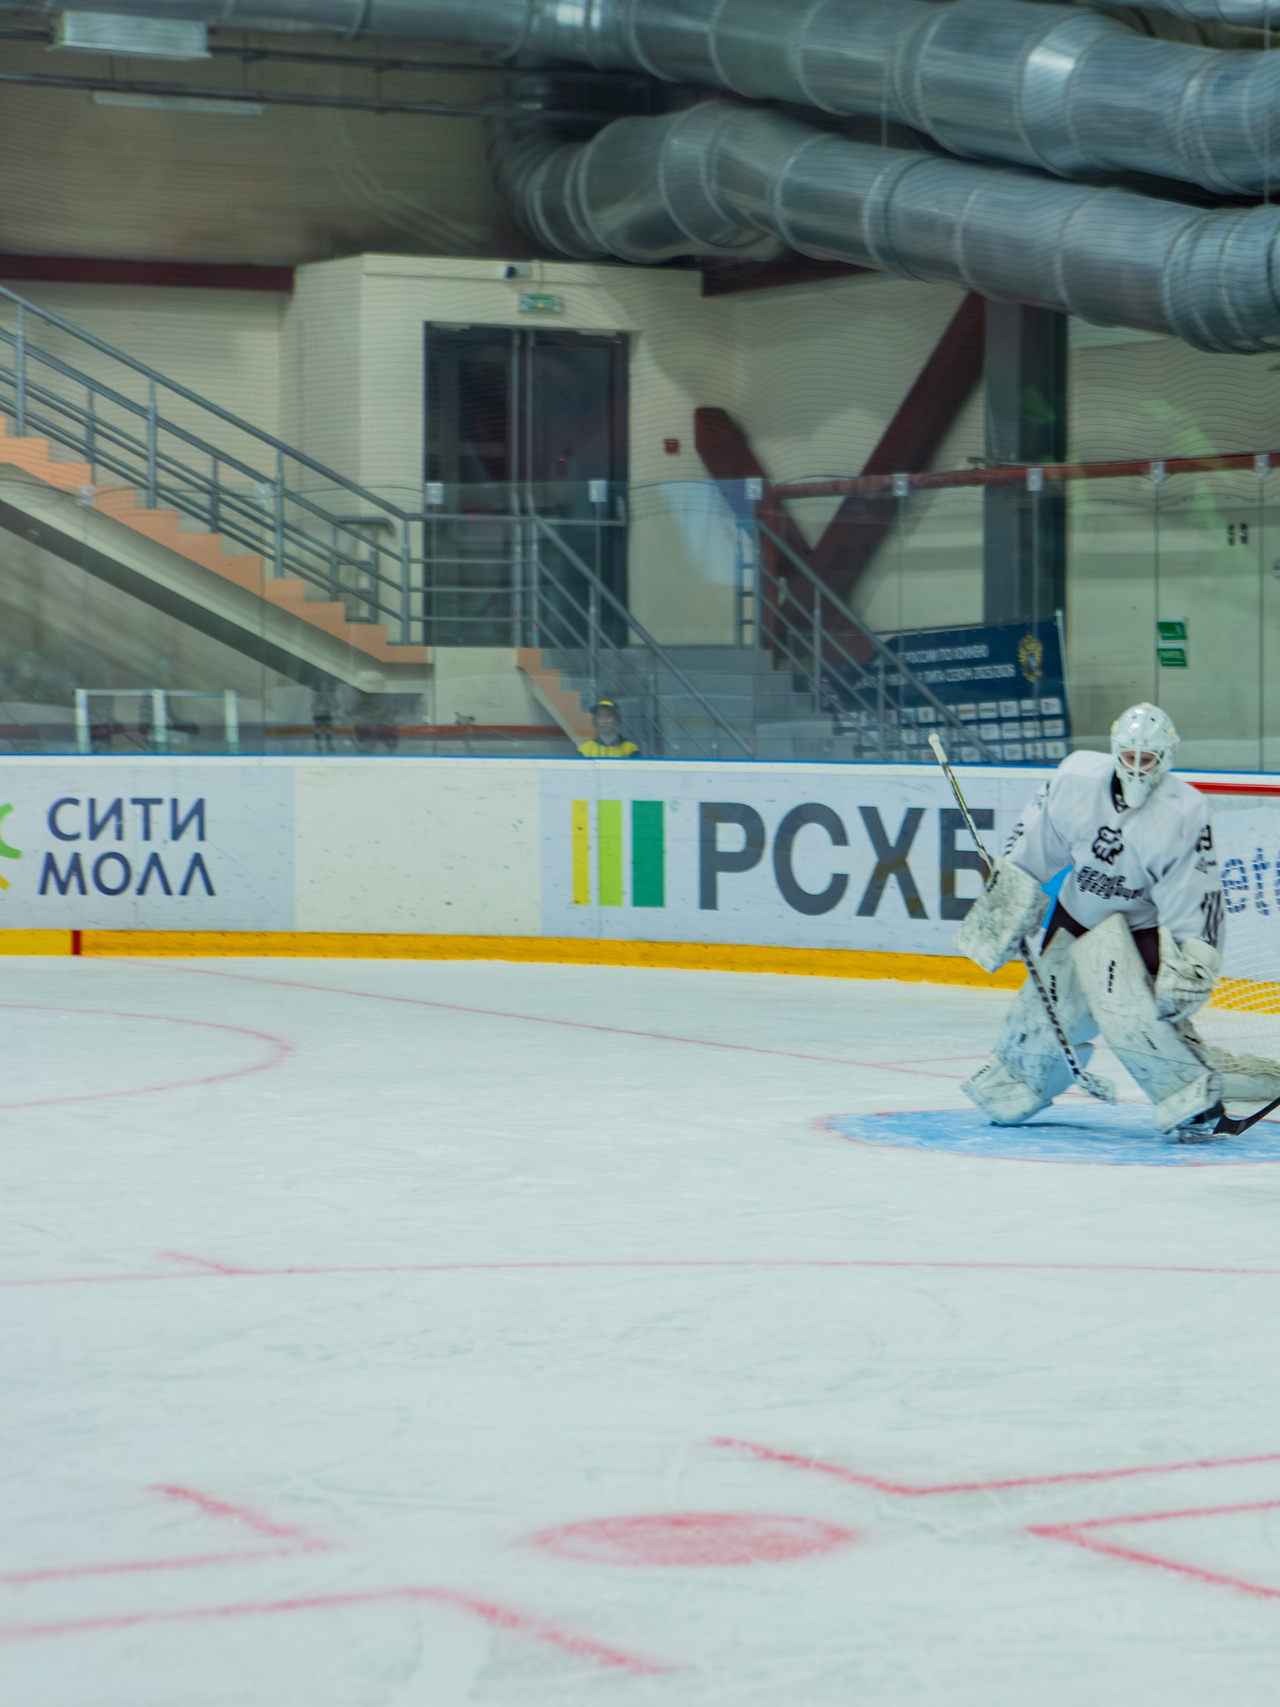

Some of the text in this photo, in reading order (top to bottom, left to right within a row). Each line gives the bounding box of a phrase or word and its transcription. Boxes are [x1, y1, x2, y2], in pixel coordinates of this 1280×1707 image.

[46, 797, 206, 842] СИТИ
[38, 851, 216, 896] МОЛЛ
[697, 801, 995, 920] РСХБ
